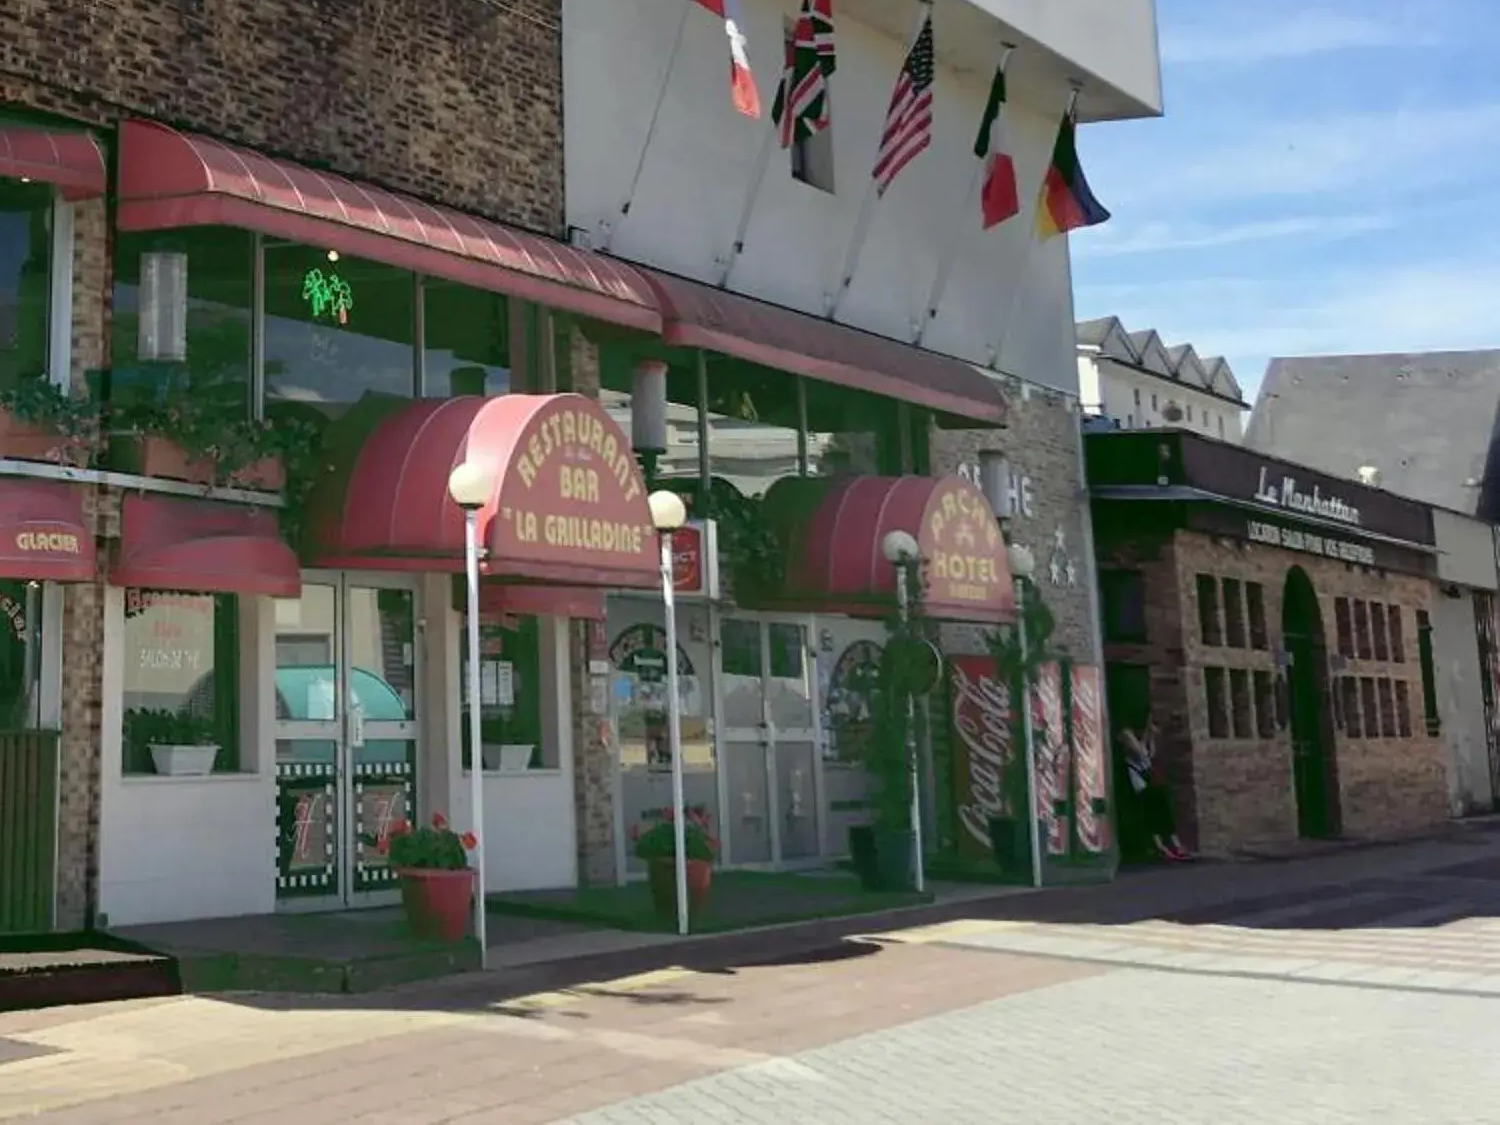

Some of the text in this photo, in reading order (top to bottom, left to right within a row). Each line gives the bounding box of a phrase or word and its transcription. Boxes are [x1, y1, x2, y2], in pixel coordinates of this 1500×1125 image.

[517, 409, 640, 502] RESTAURANT
[559, 465, 599, 504] BAR
[1254, 466, 1360, 524] Le Manhattan
[16, 532, 79, 554] GLACIER
[933, 548, 999, 584] HOTEL
